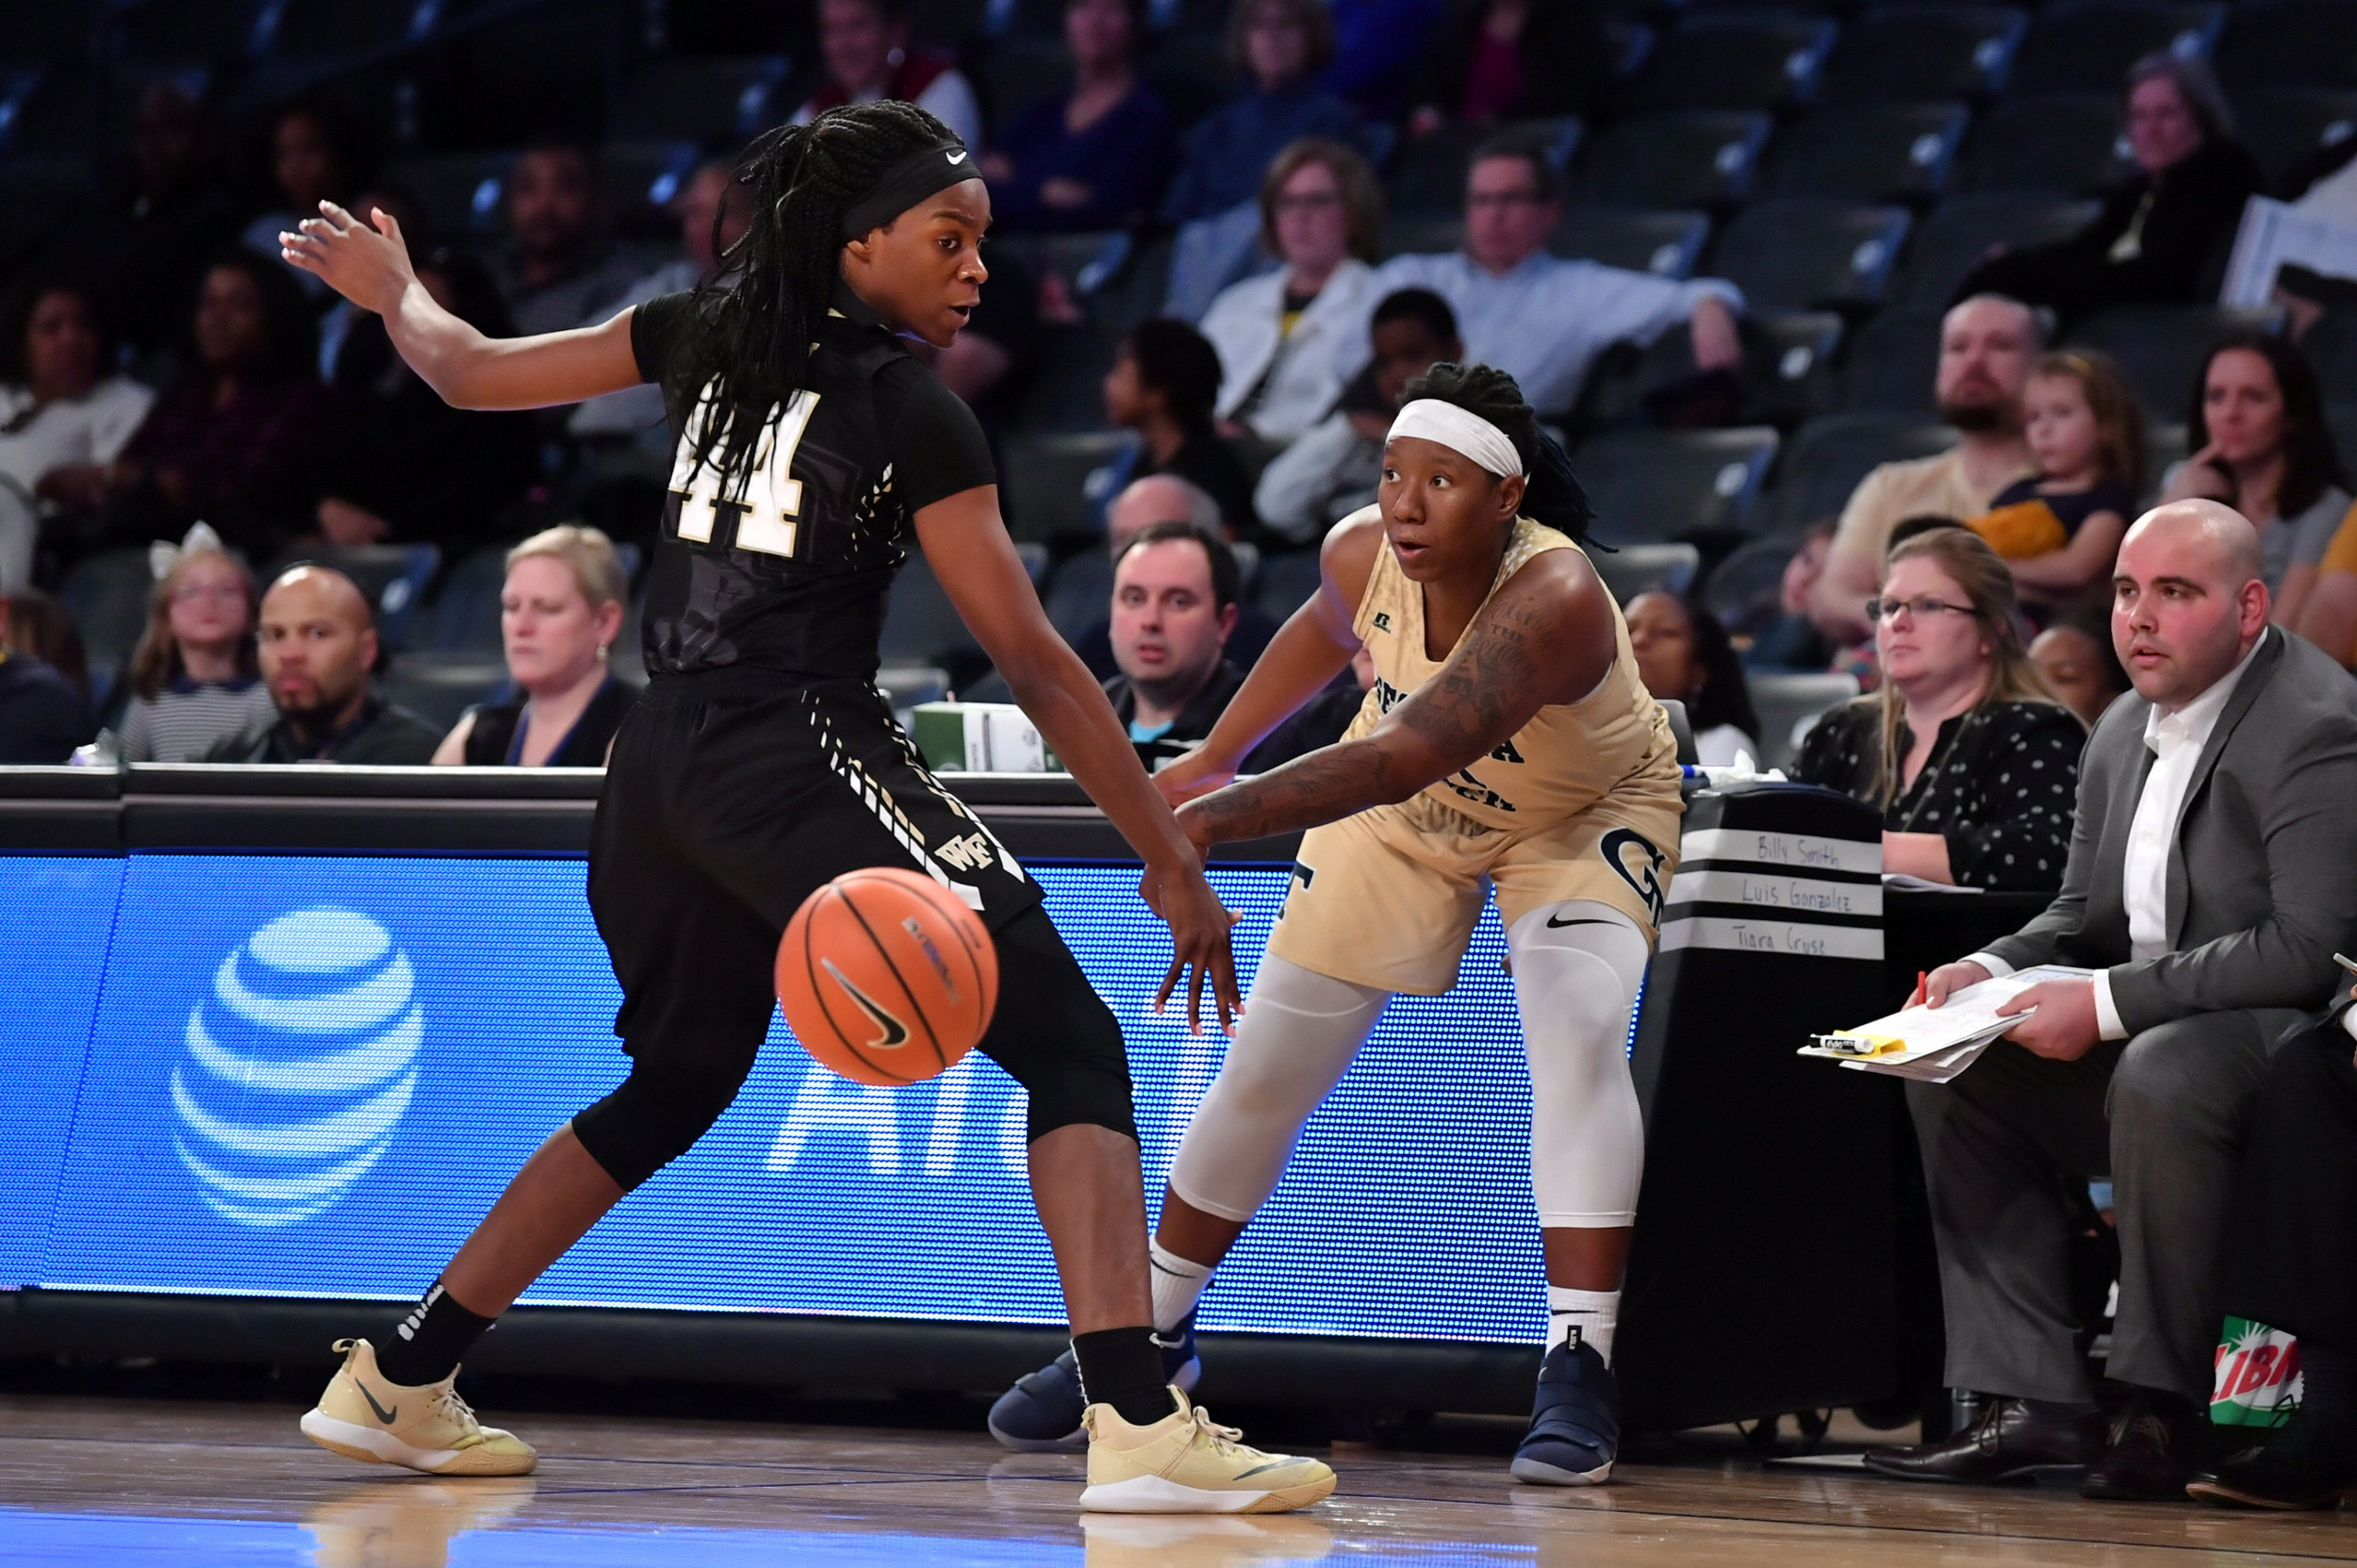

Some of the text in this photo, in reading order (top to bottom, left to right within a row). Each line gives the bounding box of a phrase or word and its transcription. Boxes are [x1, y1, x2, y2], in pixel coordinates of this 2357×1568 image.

[668, 371, 821, 558] 44
[1758, 835, 1838, 866] Billy Smith
[1742, 879, 1852, 912] Luis Gonzalez
[1732, 925, 1774, 949] Tiara
